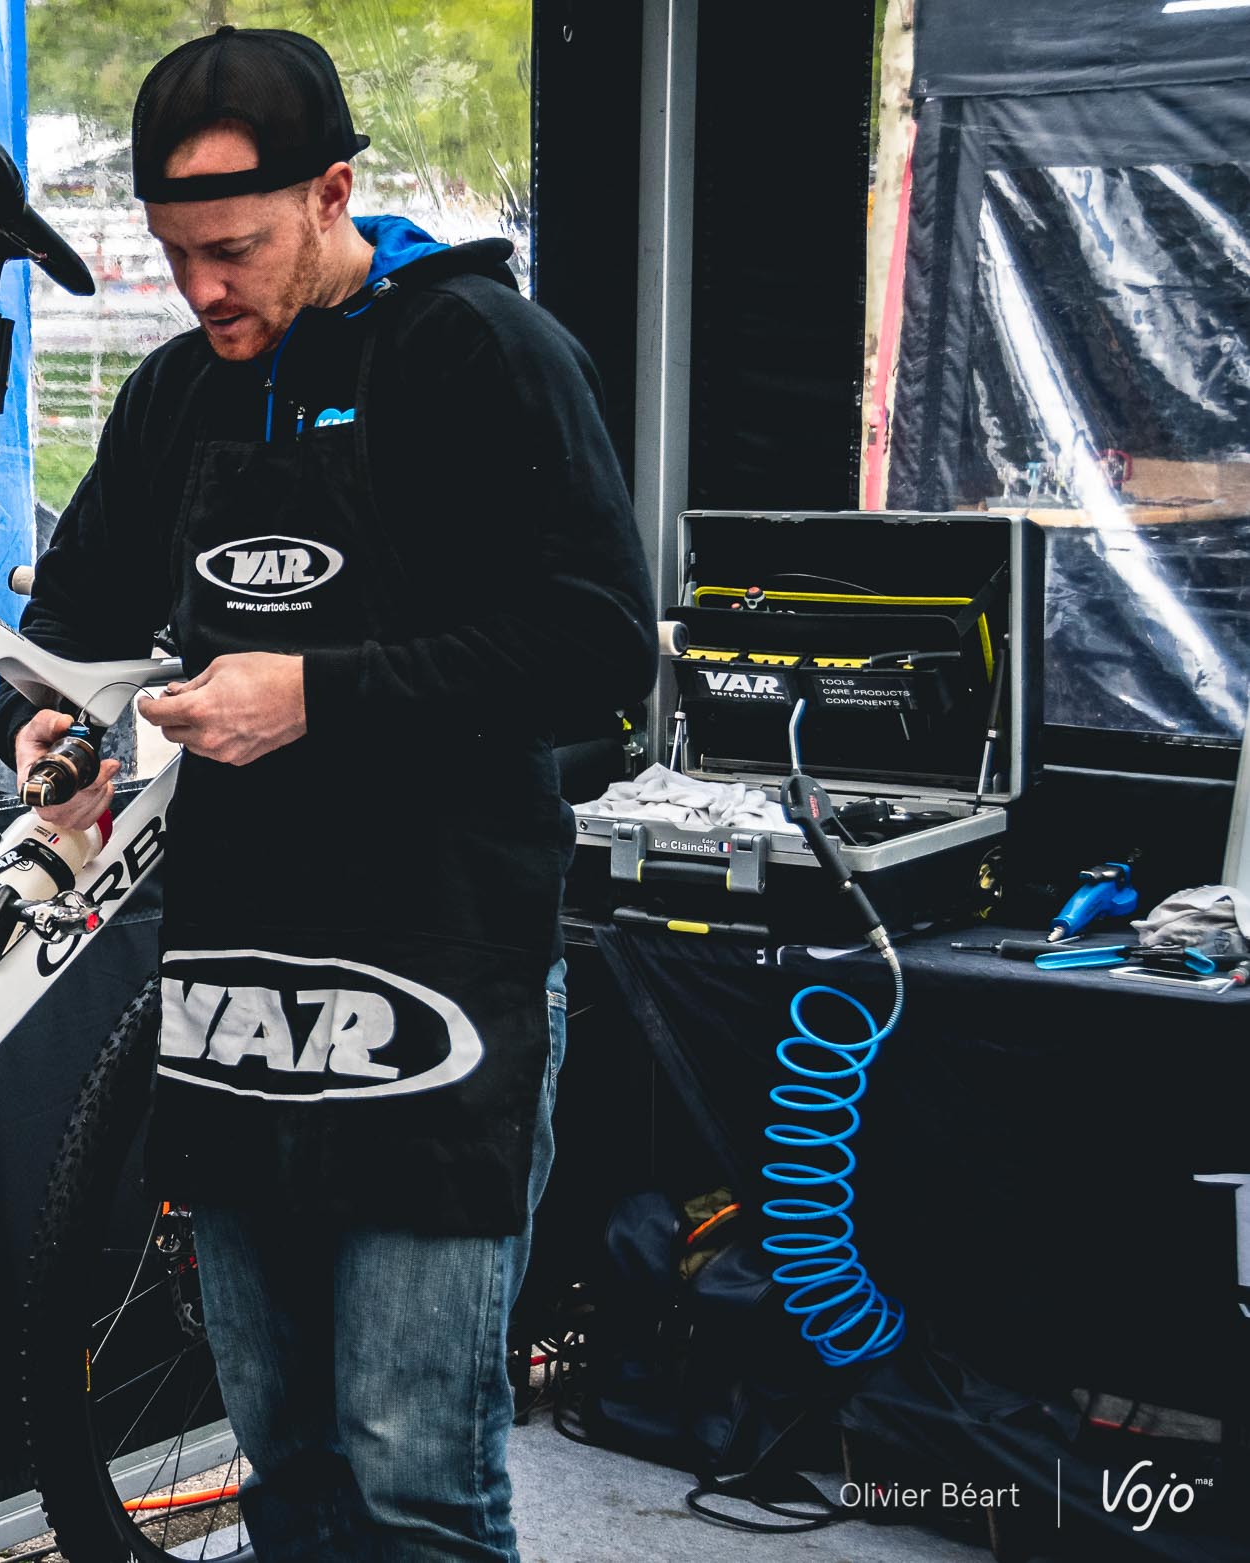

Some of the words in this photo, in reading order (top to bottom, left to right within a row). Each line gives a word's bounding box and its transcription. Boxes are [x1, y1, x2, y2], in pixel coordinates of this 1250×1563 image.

[226, 548, 315, 585] VAR
[226, 600, 313, 612] www.vartools.com
[697, 670, 784, 695] VAR
[710, 690, 785, 700] vartools.com
[853, 689, 911, 697] PRODUCTS
[825, 698, 900, 706] COMPONENTS
[654, 839, 667, 849] Le
[670, 840, 717, 854] Clainche
[160, 977, 399, 1079] VAR
